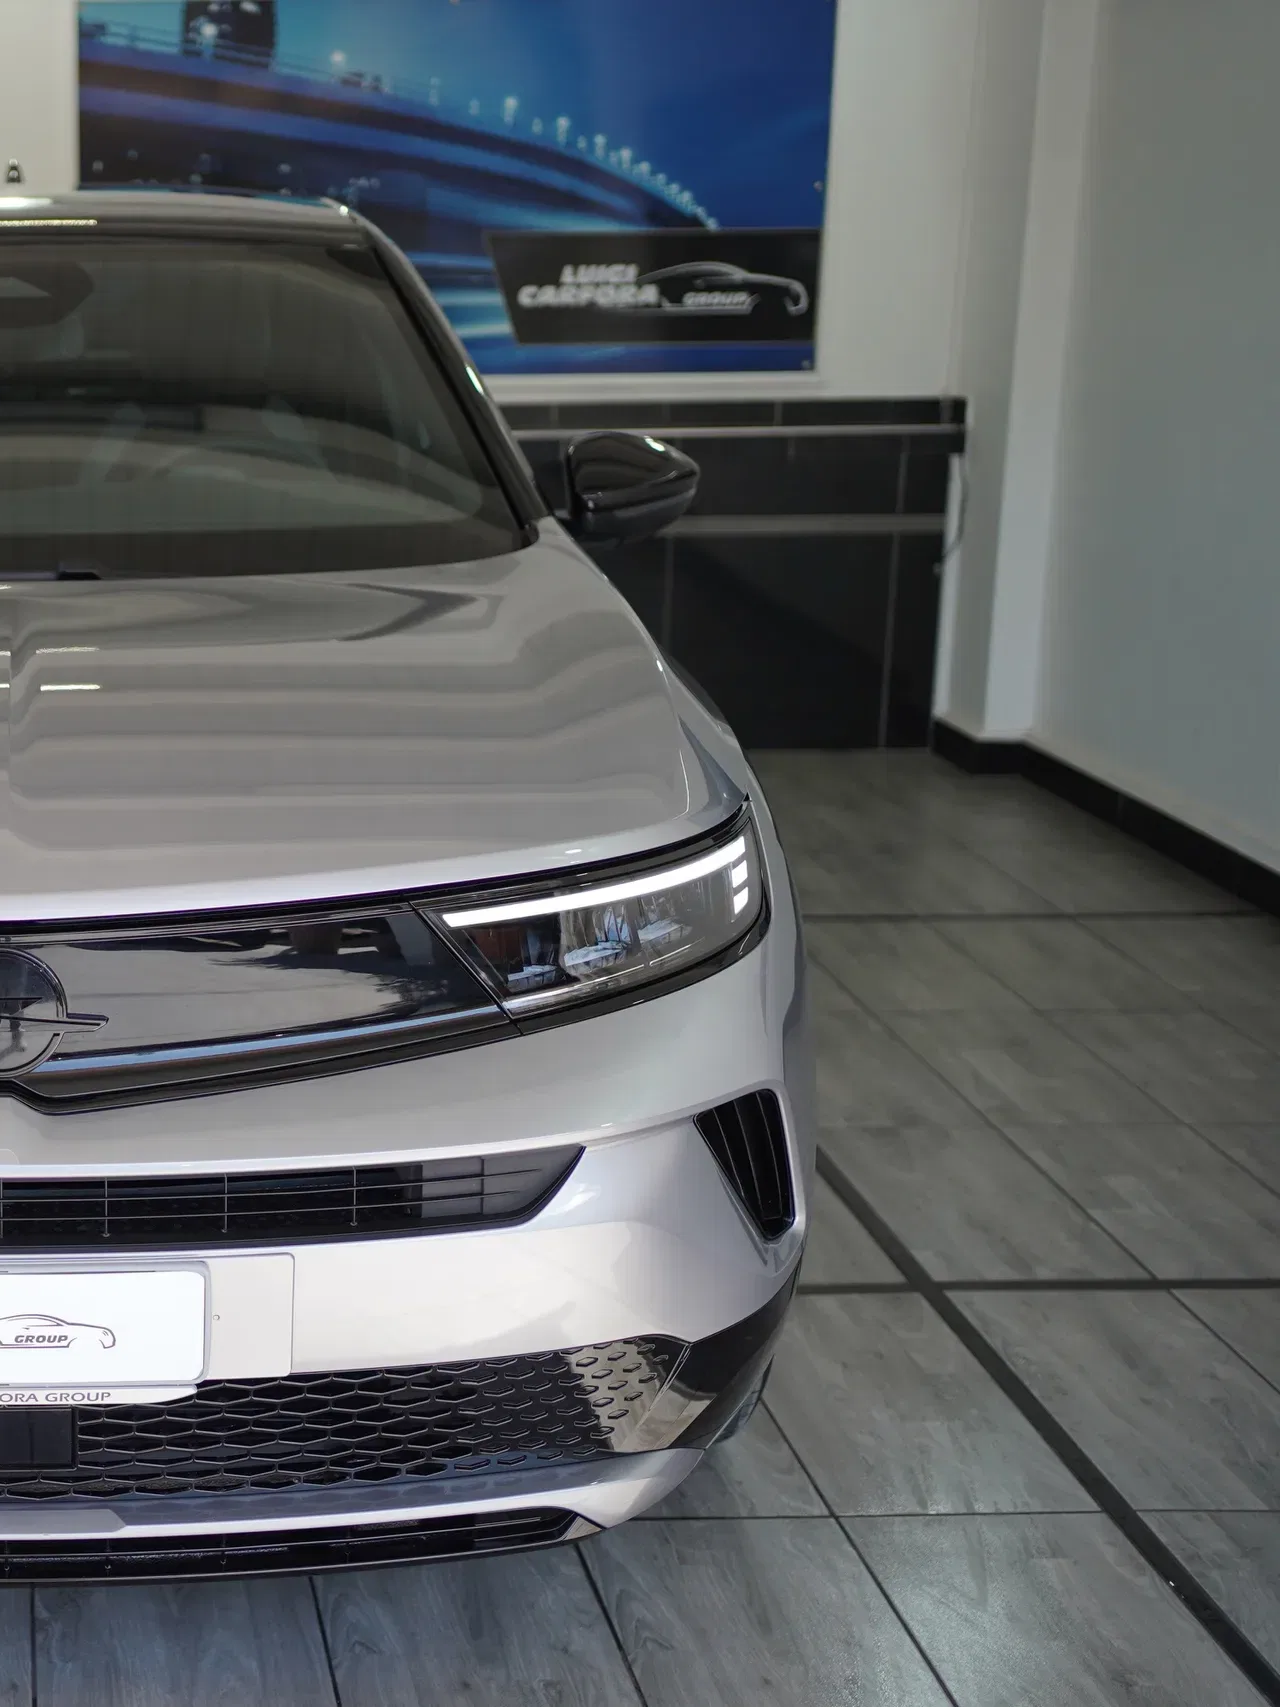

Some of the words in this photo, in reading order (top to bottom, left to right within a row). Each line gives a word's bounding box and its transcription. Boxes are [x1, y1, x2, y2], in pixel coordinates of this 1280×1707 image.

[559, 264, 640, 284] LUIGI
[517, 284, 660, 308] CARFORA
[14, 1334, 68, 1344] GROUP
[45, 1392, 112, 1402] GROUP
